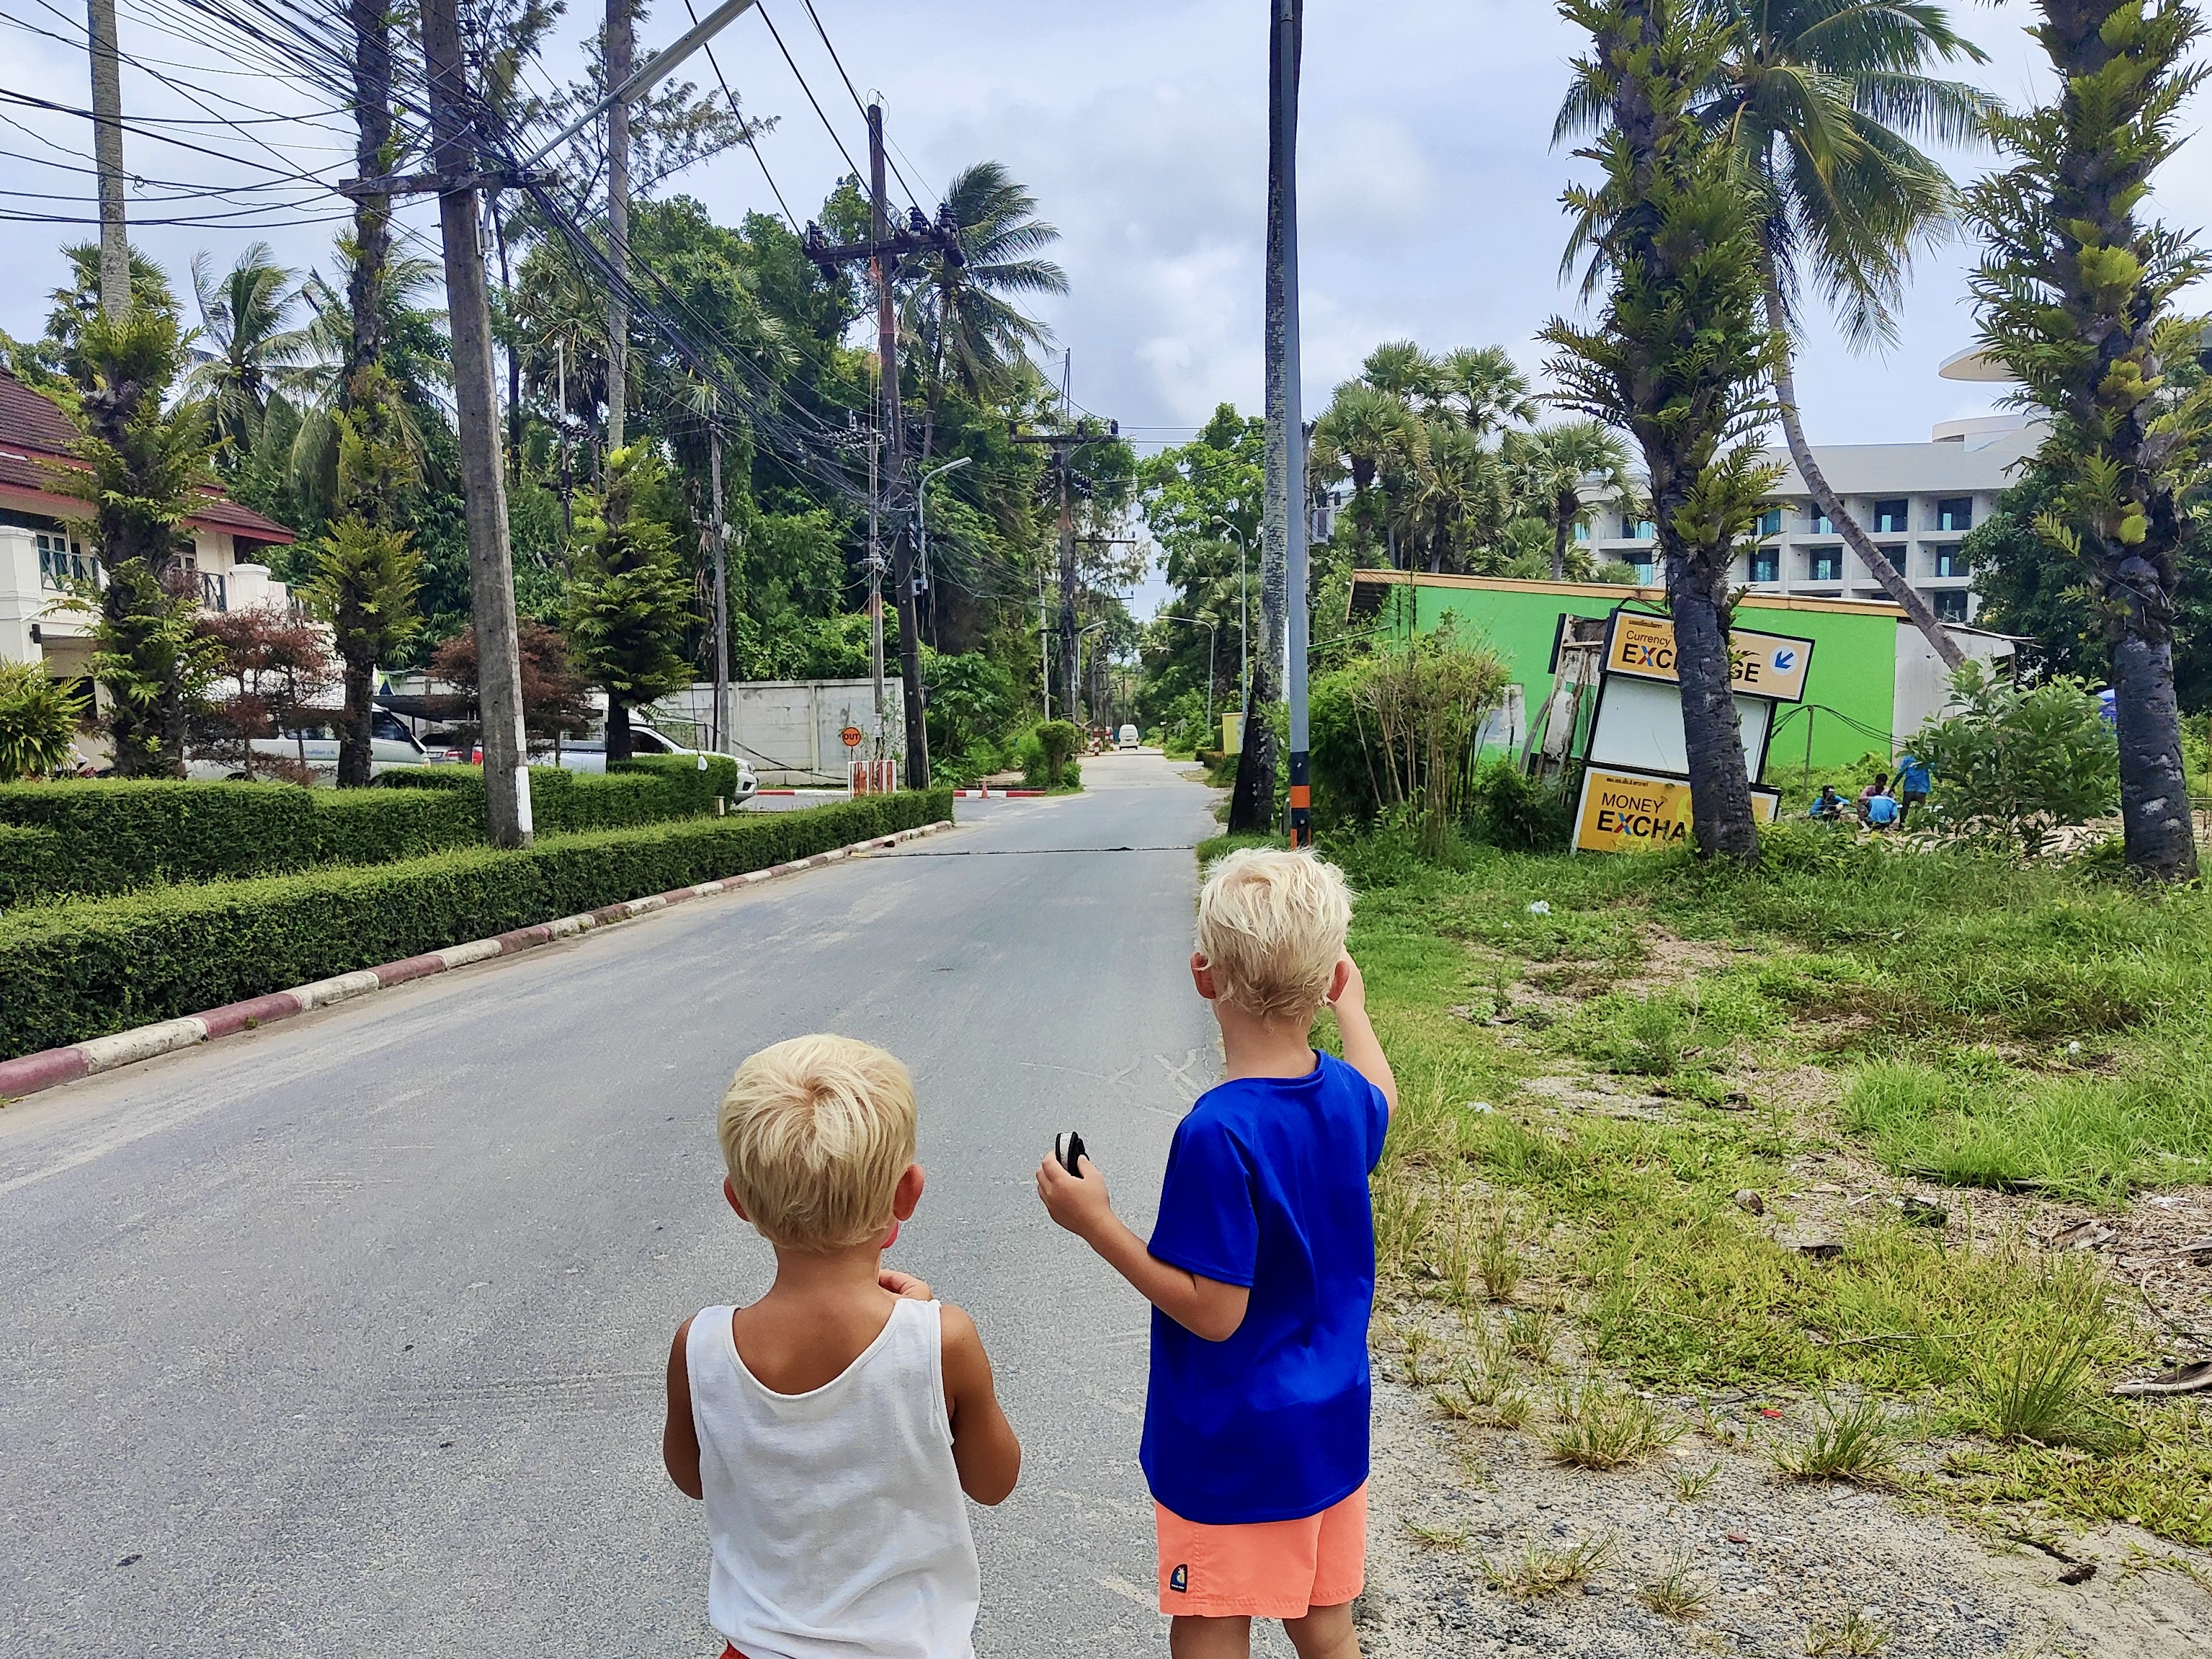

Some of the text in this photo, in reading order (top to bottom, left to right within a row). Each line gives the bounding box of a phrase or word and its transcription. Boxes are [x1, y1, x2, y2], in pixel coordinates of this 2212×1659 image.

[1626, 630, 1671, 647] Currency
[1622, 643, 1761, 683] EXCGE
[1602, 793, 1664, 814] MONEY
